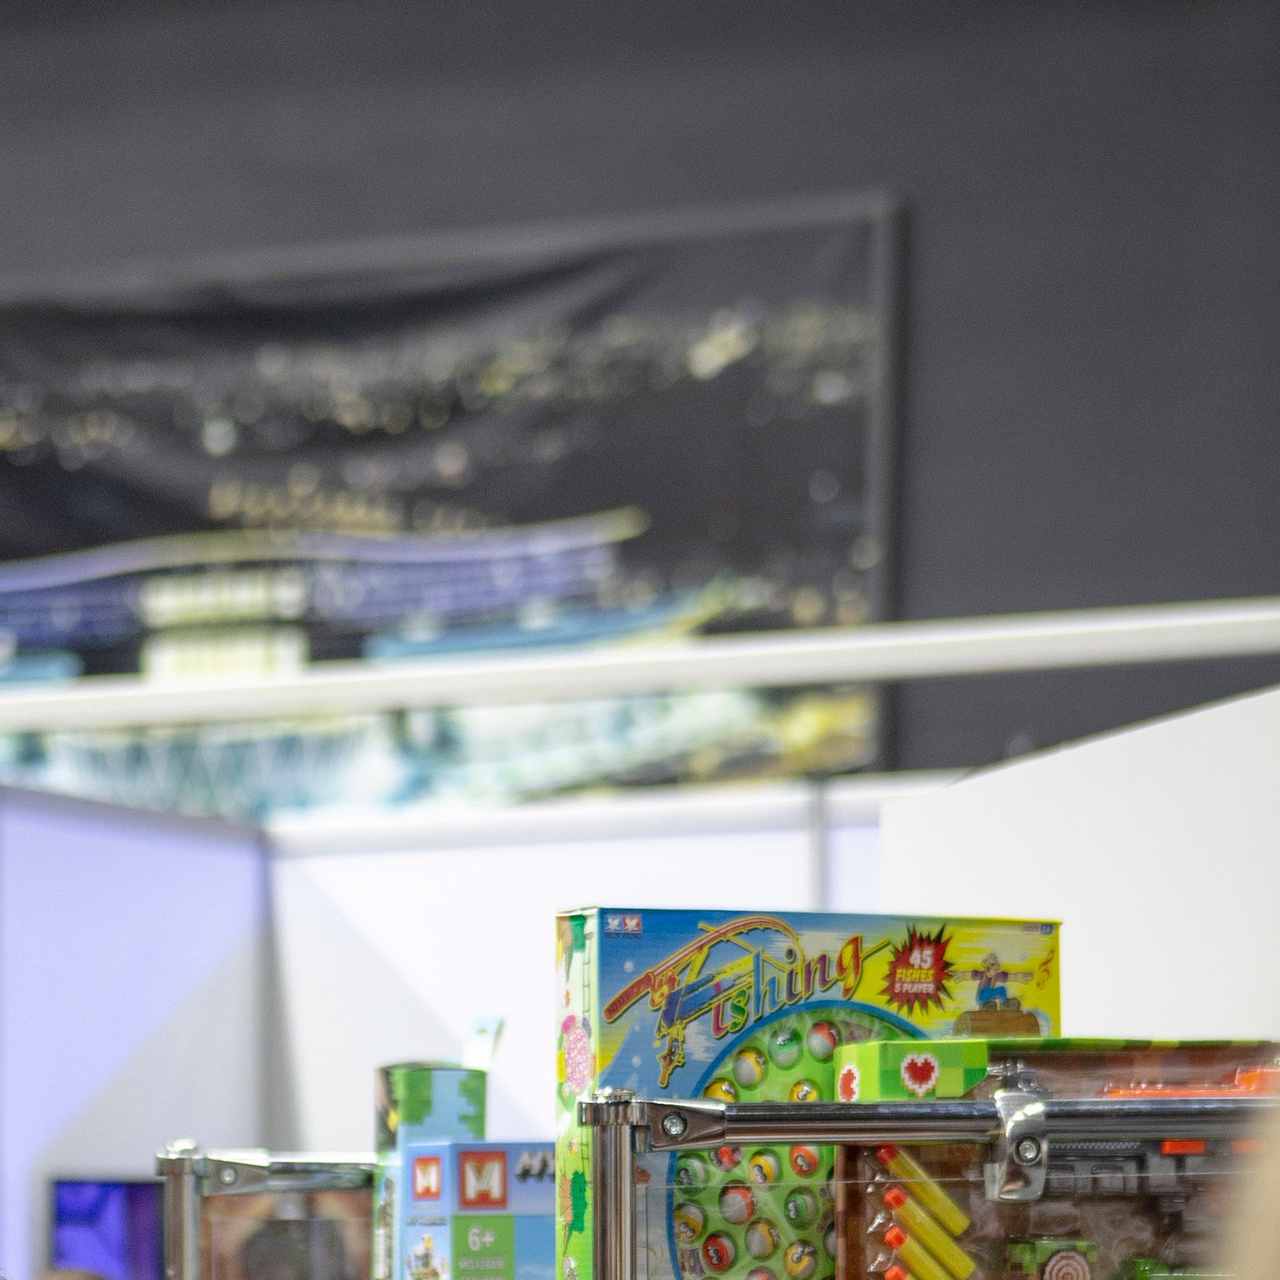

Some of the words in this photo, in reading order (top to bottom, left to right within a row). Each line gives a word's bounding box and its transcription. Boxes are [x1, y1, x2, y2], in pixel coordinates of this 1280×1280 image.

[909, 948, 933, 970] 45
[895, 969, 934, 983] FISHES
[902, 982, 935, 994] PLAYER
[468, 1227, 495, 1251] 6+
